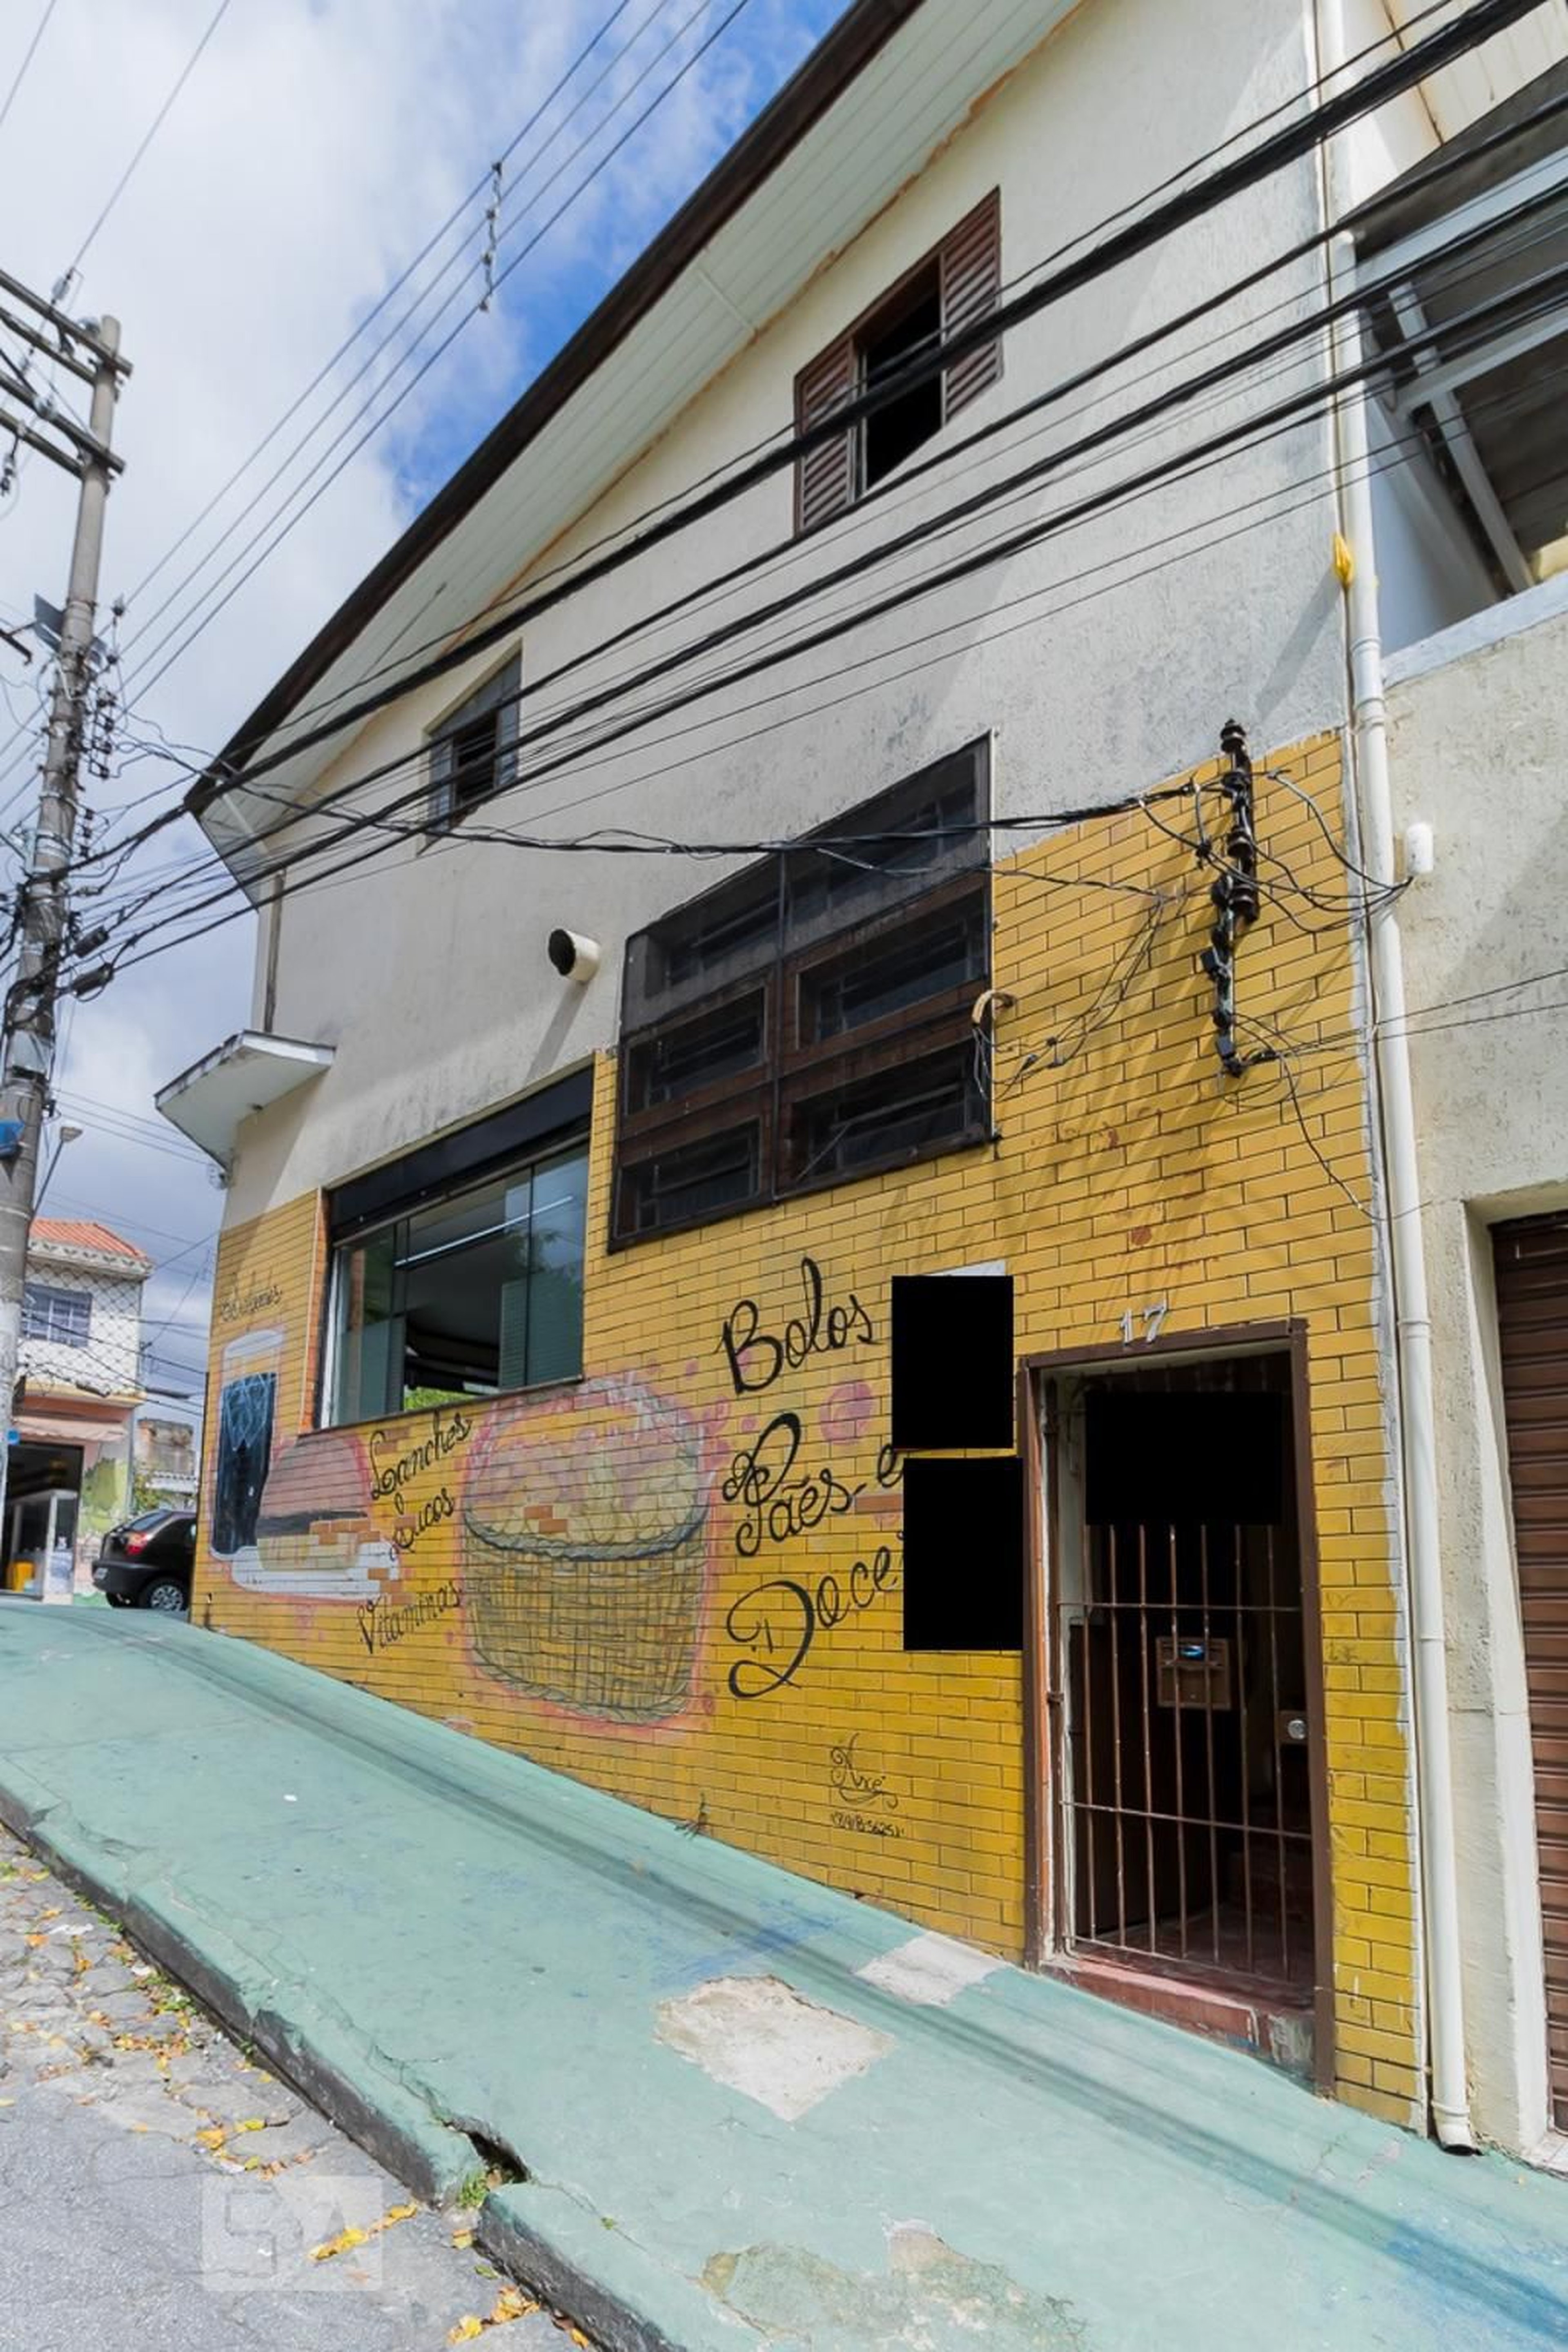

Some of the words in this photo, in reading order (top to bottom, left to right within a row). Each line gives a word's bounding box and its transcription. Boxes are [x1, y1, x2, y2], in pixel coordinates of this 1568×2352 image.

[714, 1257, 883, 1395] Bolos
[1120, 1299, 1167, 1343] 17
[370, 1409, 473, 1500] Lanches
[722, 1412, 867, 1557] Pães
[357, 1580, 463, 1654] Vitaminas
[726, 1530, 904, 1699] Doce
